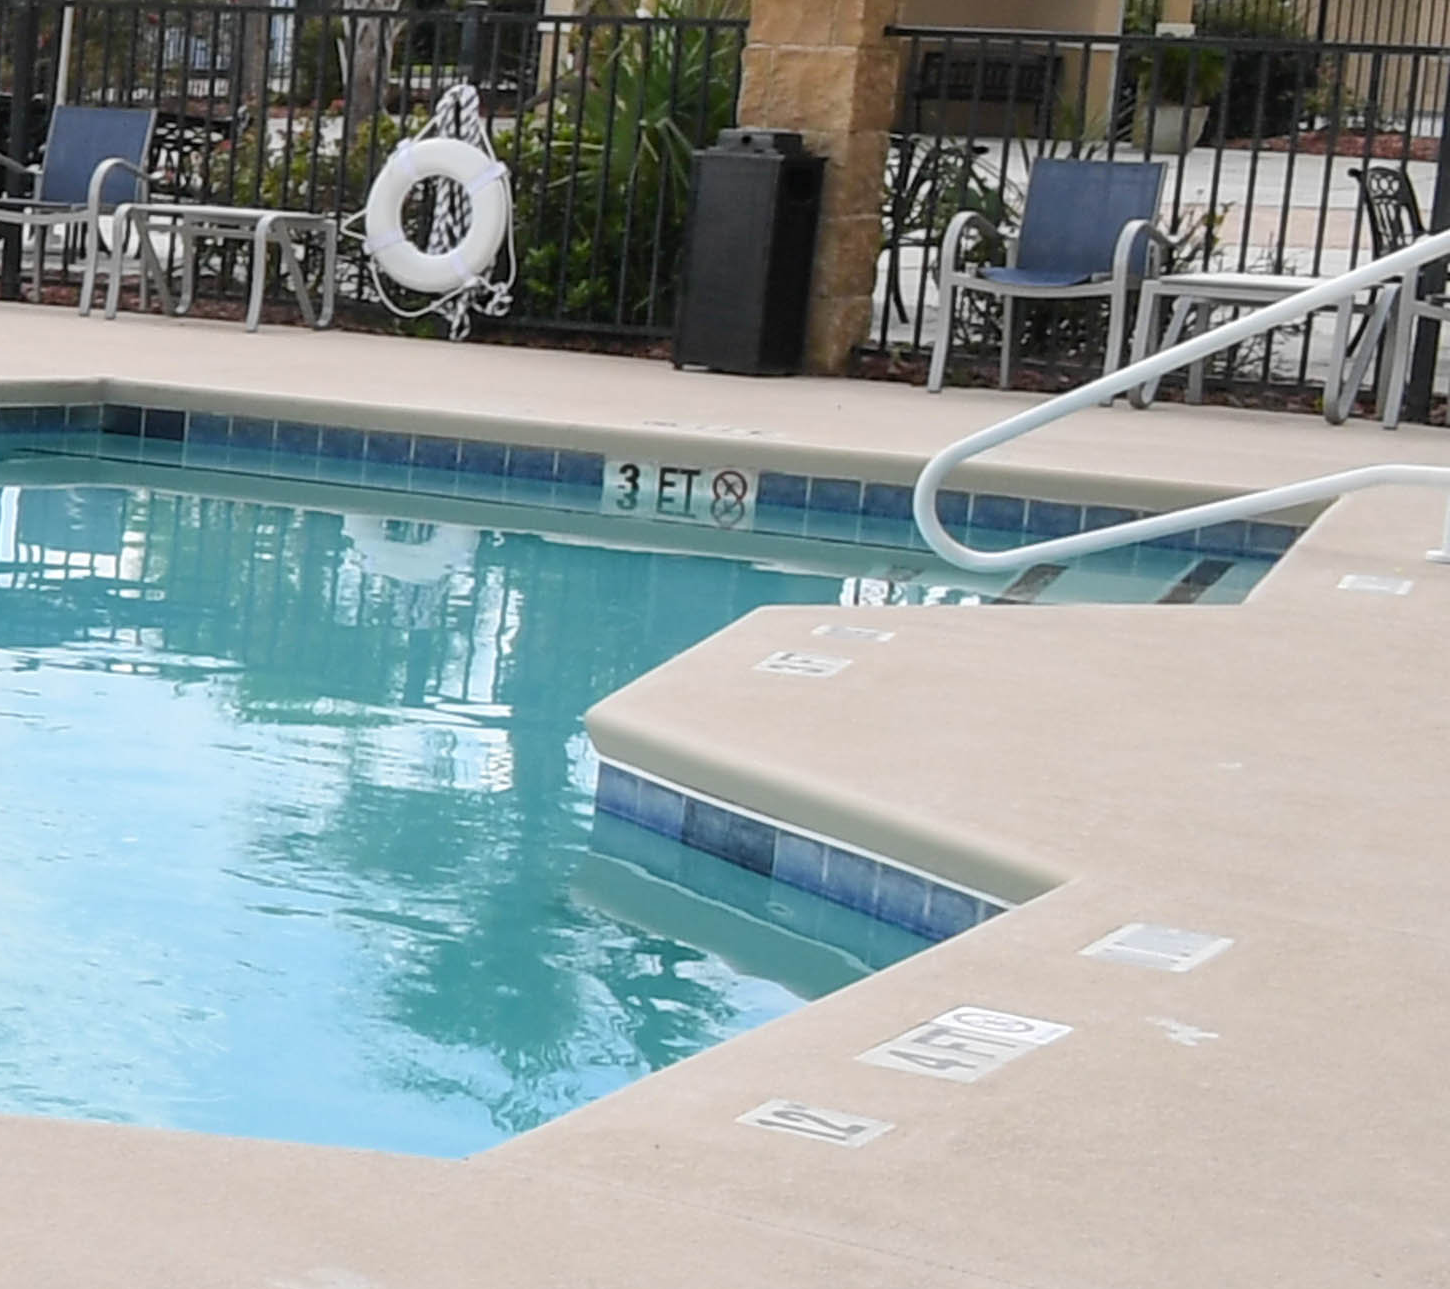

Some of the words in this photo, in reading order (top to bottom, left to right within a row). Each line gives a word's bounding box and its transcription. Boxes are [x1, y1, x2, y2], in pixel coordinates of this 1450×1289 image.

[617, 464, 640, 489] 3
[658, 466, 701, 494] FT
[911, 1027, 1018, 1059] FT
[888, 1049, 978, 1070] 4
